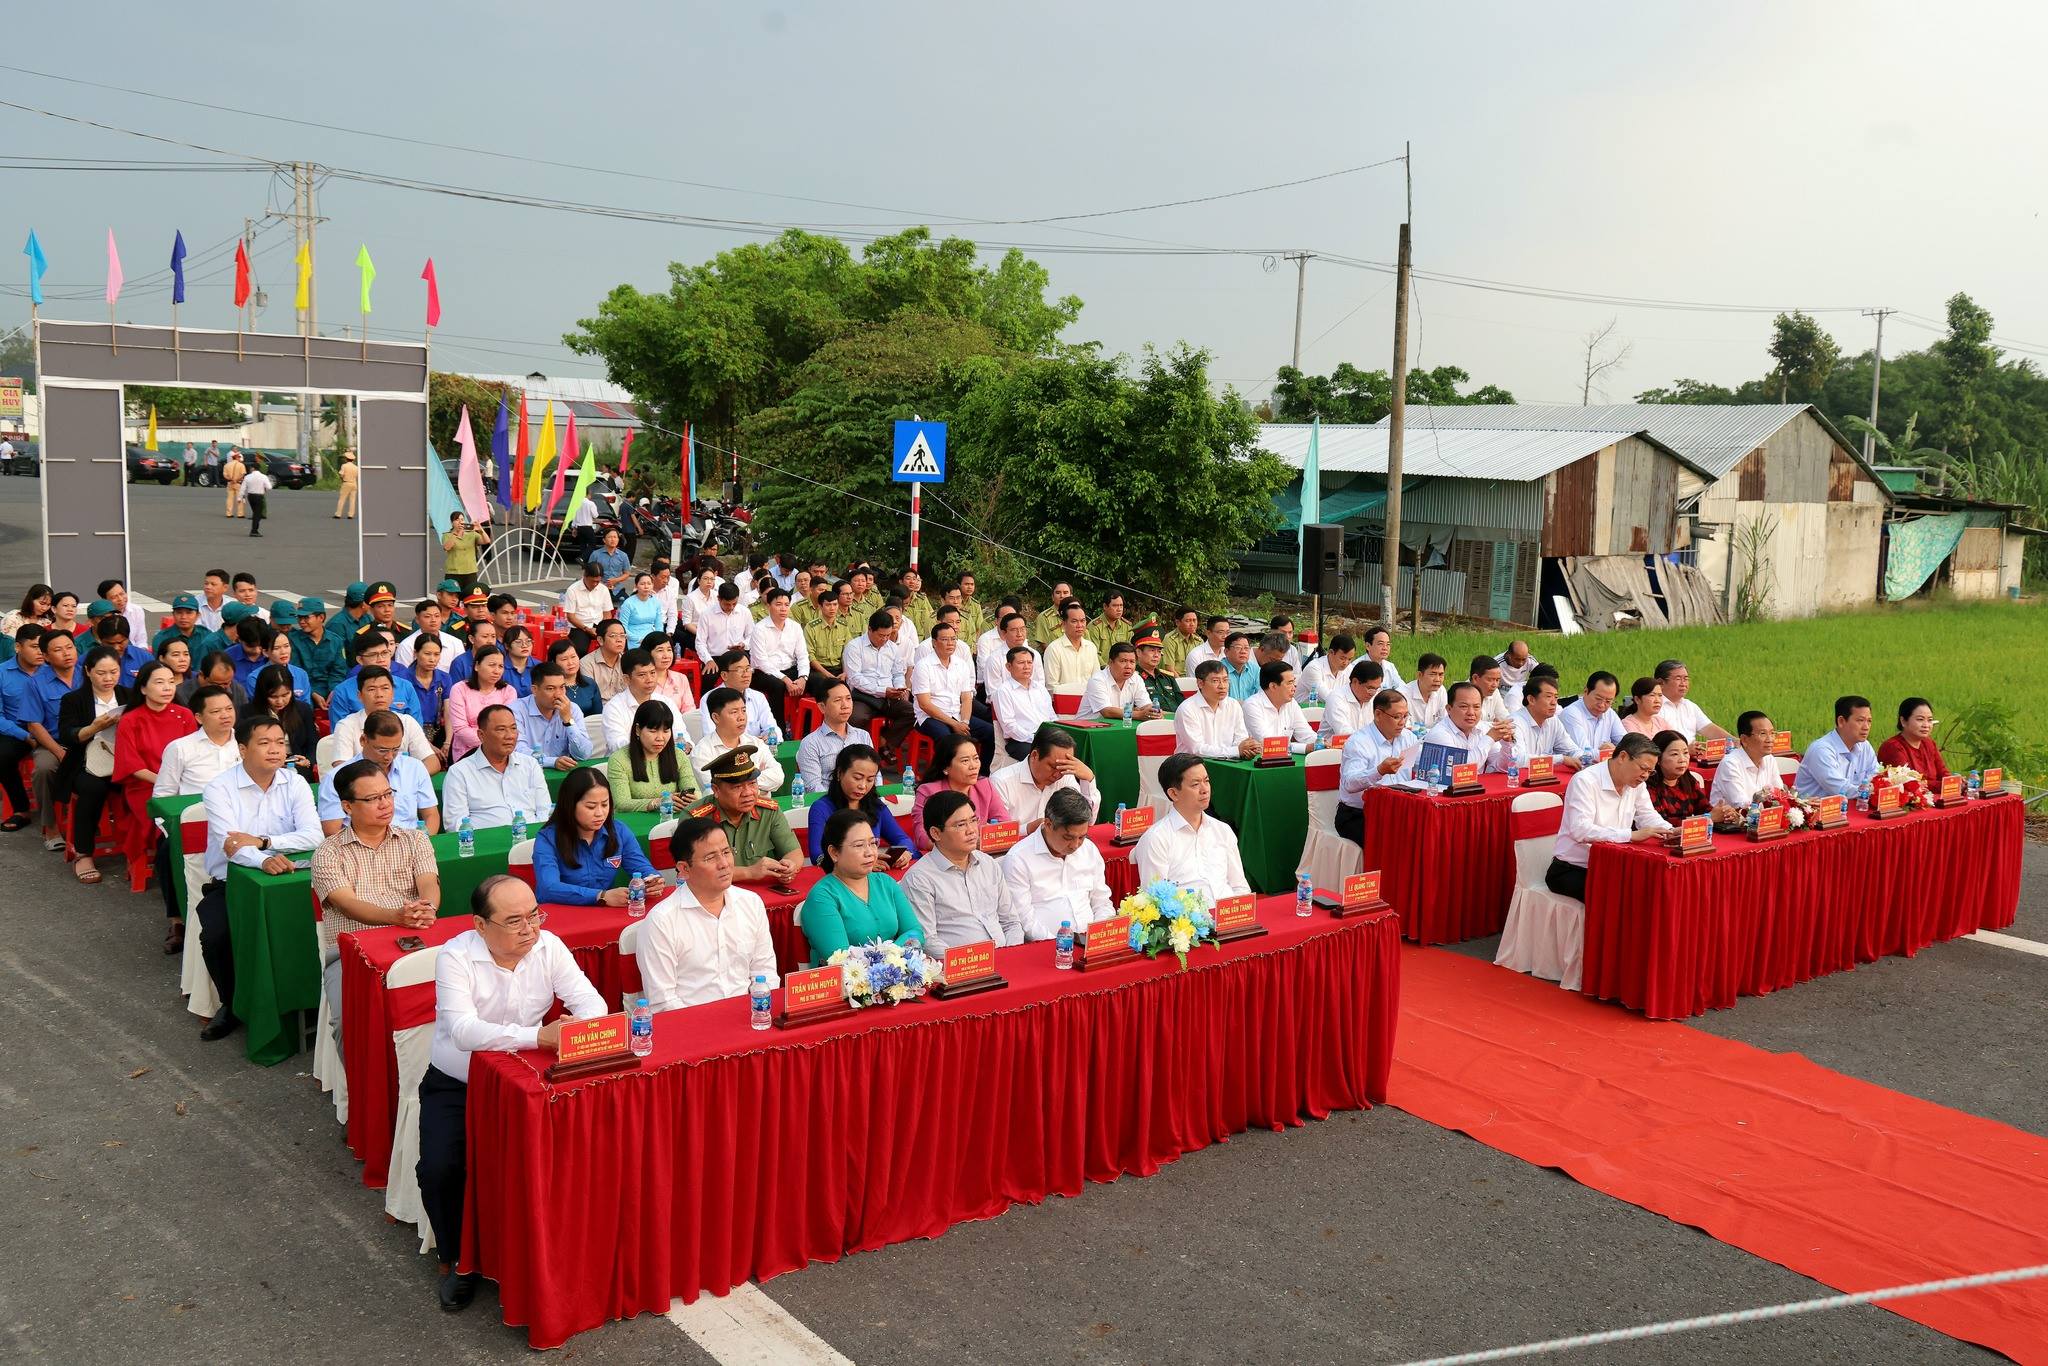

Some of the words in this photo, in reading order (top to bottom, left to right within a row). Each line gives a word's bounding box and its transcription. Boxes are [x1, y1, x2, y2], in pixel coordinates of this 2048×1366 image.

[3, 389, 18, 397] GIA
[2, 398, 20, 406] HUY
[807, 981, 819, 992] VĂN
[587, 1021, 600, 1029] ÔNG
[587, 1030, 599, 1042] VĂN
